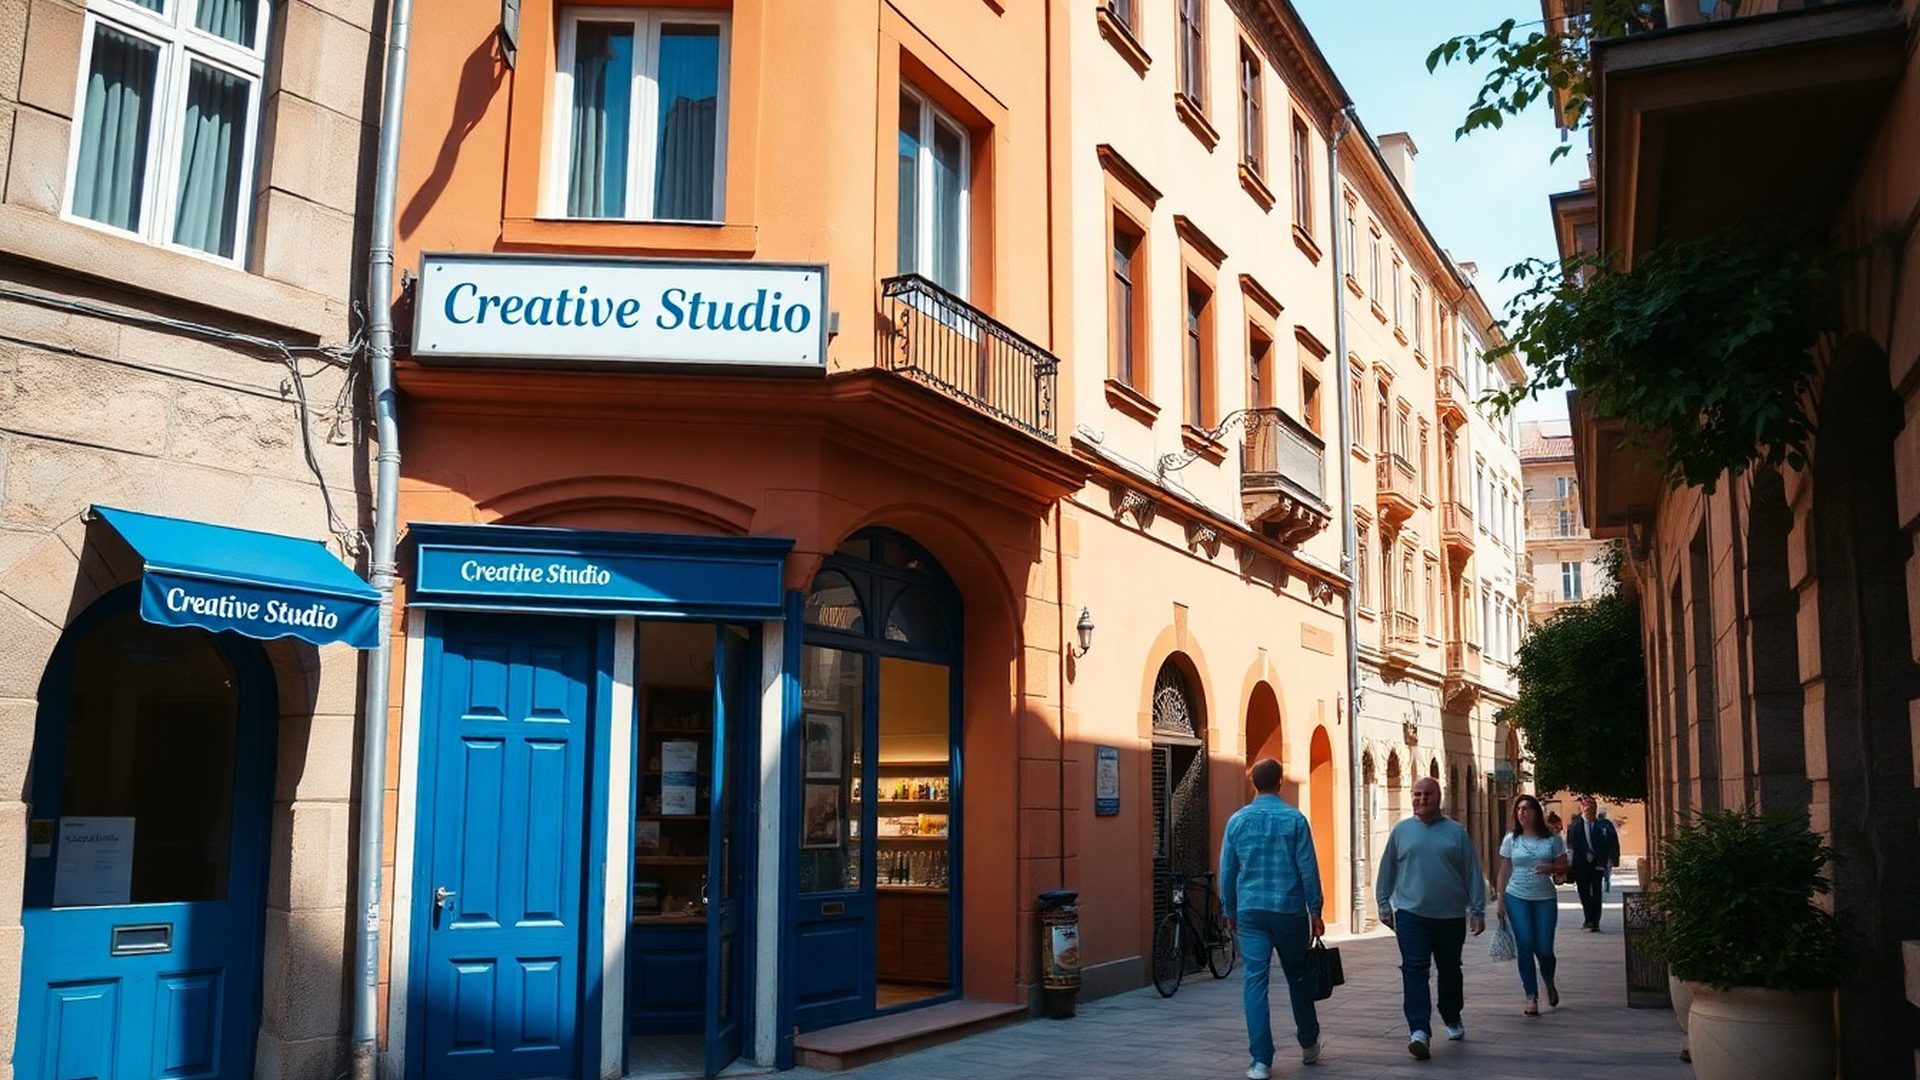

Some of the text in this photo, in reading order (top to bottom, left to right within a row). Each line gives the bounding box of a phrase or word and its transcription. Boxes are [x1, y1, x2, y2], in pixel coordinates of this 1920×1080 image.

[444, 282, 811, 333] Creative Studio
[166, 587, 338, 629] Creative Studio
